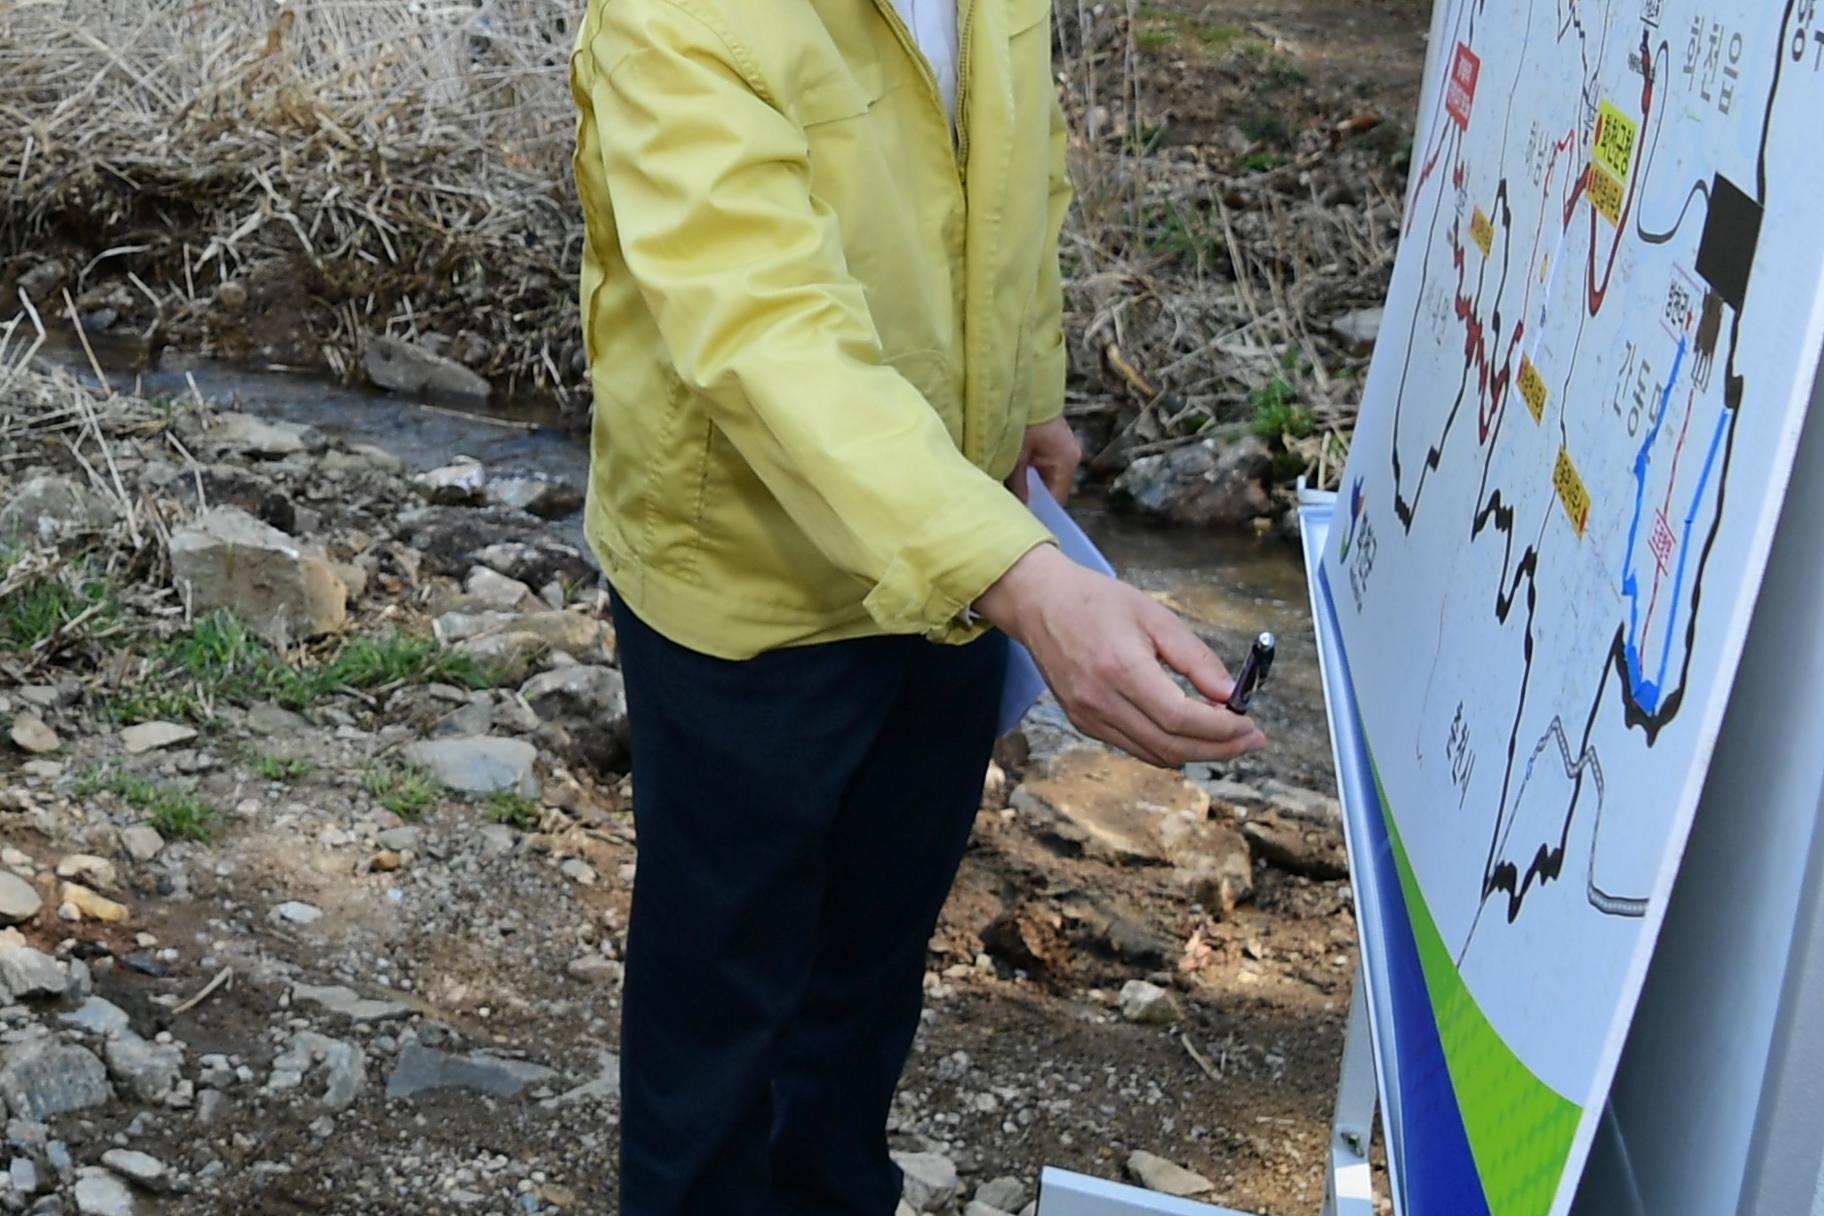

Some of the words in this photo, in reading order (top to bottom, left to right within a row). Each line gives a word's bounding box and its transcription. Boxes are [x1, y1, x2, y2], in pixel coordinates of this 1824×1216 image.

[1683, 16, 1742, 115] 화천읍
[1601, 114, 1632, 177] 화천군청
[1666, 279, 1688, 332] 방천리
[1446, 700, 1475, 811] 춘천시
